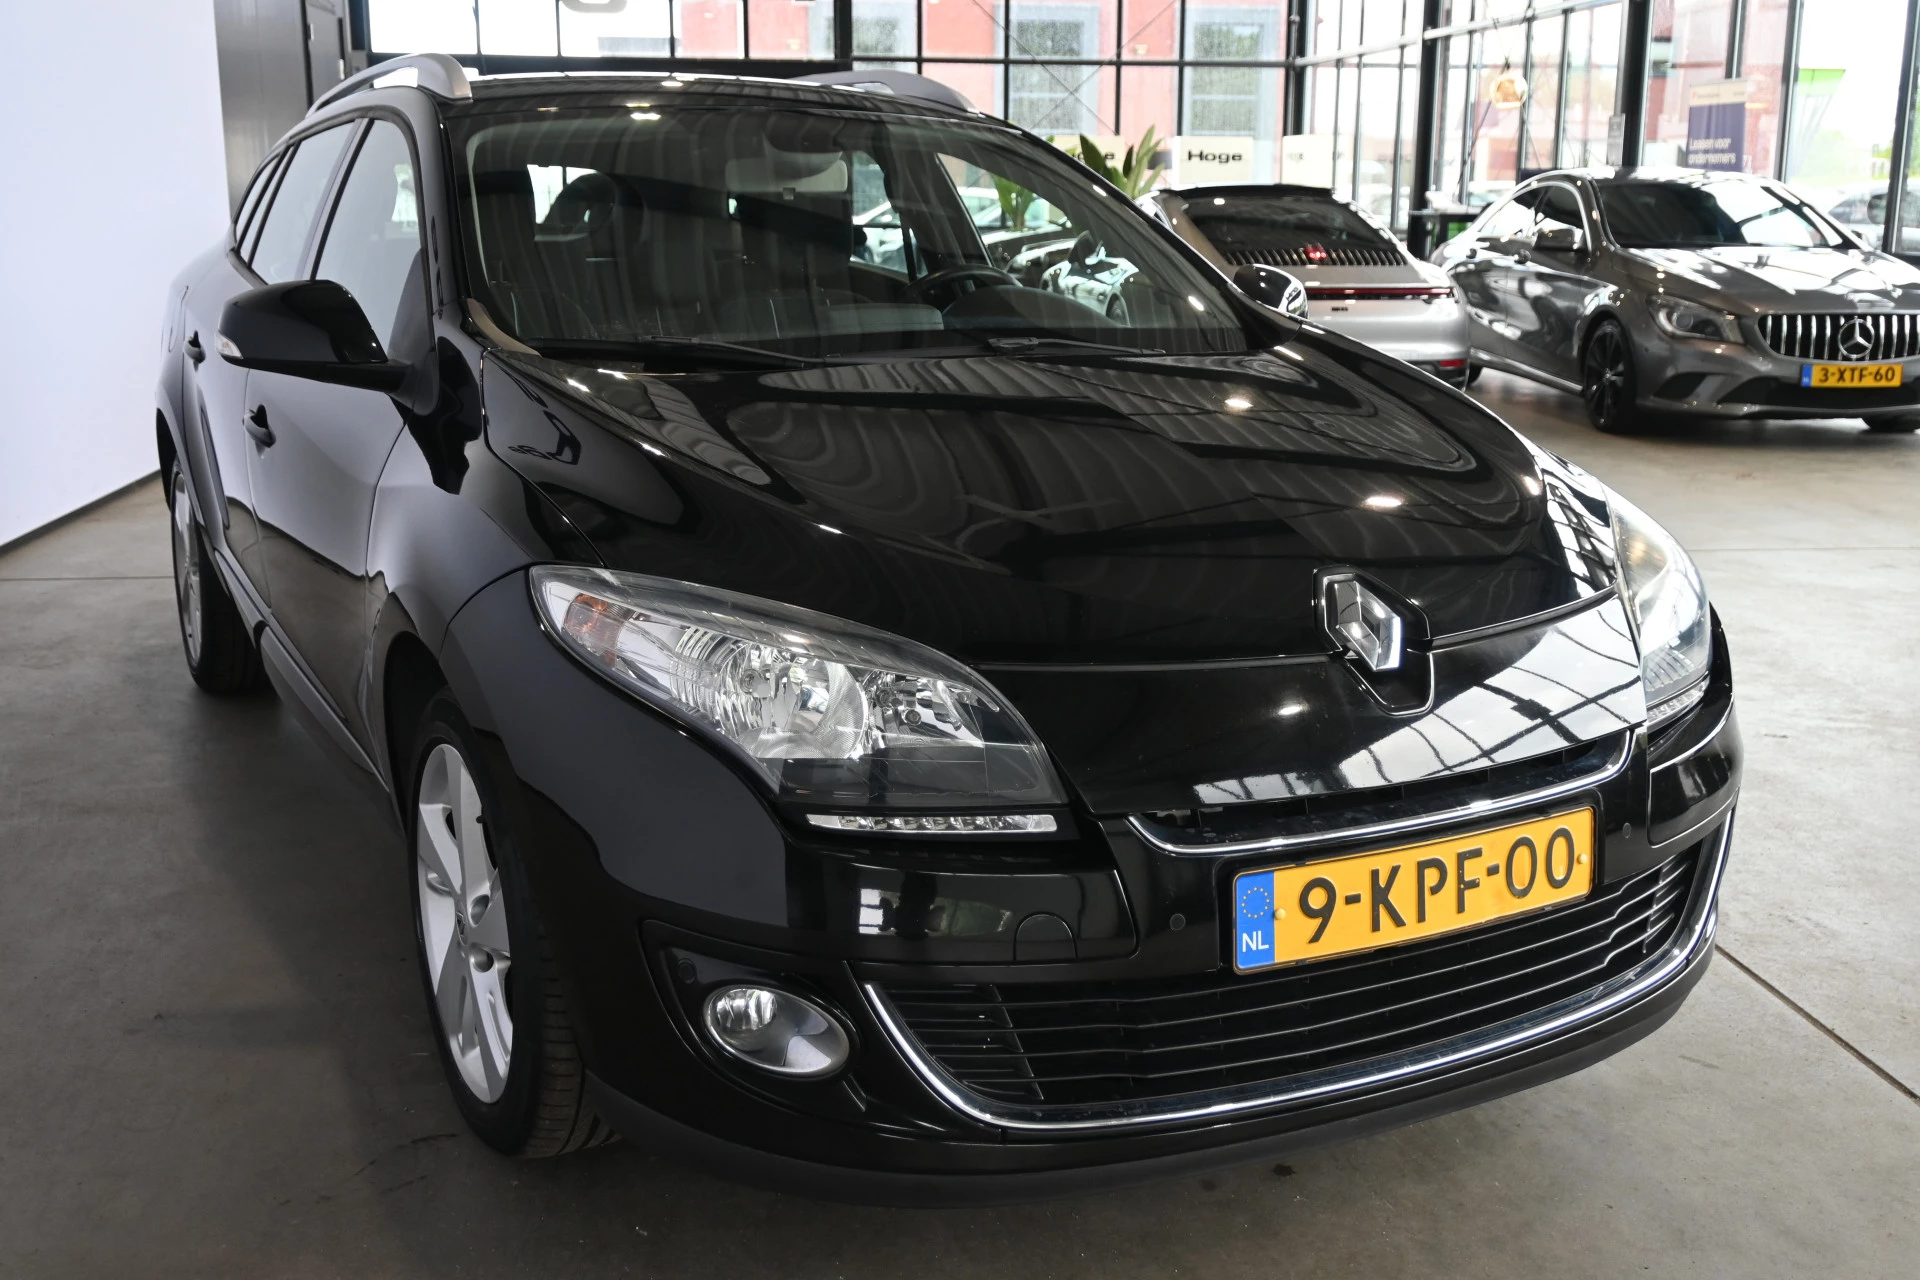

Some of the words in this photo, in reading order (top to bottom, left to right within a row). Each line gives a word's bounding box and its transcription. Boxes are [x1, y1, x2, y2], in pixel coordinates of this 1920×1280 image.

[1187, 150, 1242, 163] Hoge
[1819, 366, 1896, 383] 3-XTF-60
[1299, 827, 1575, 944] 9-KPF-00
[1241, 930, 1270, 952] NL
